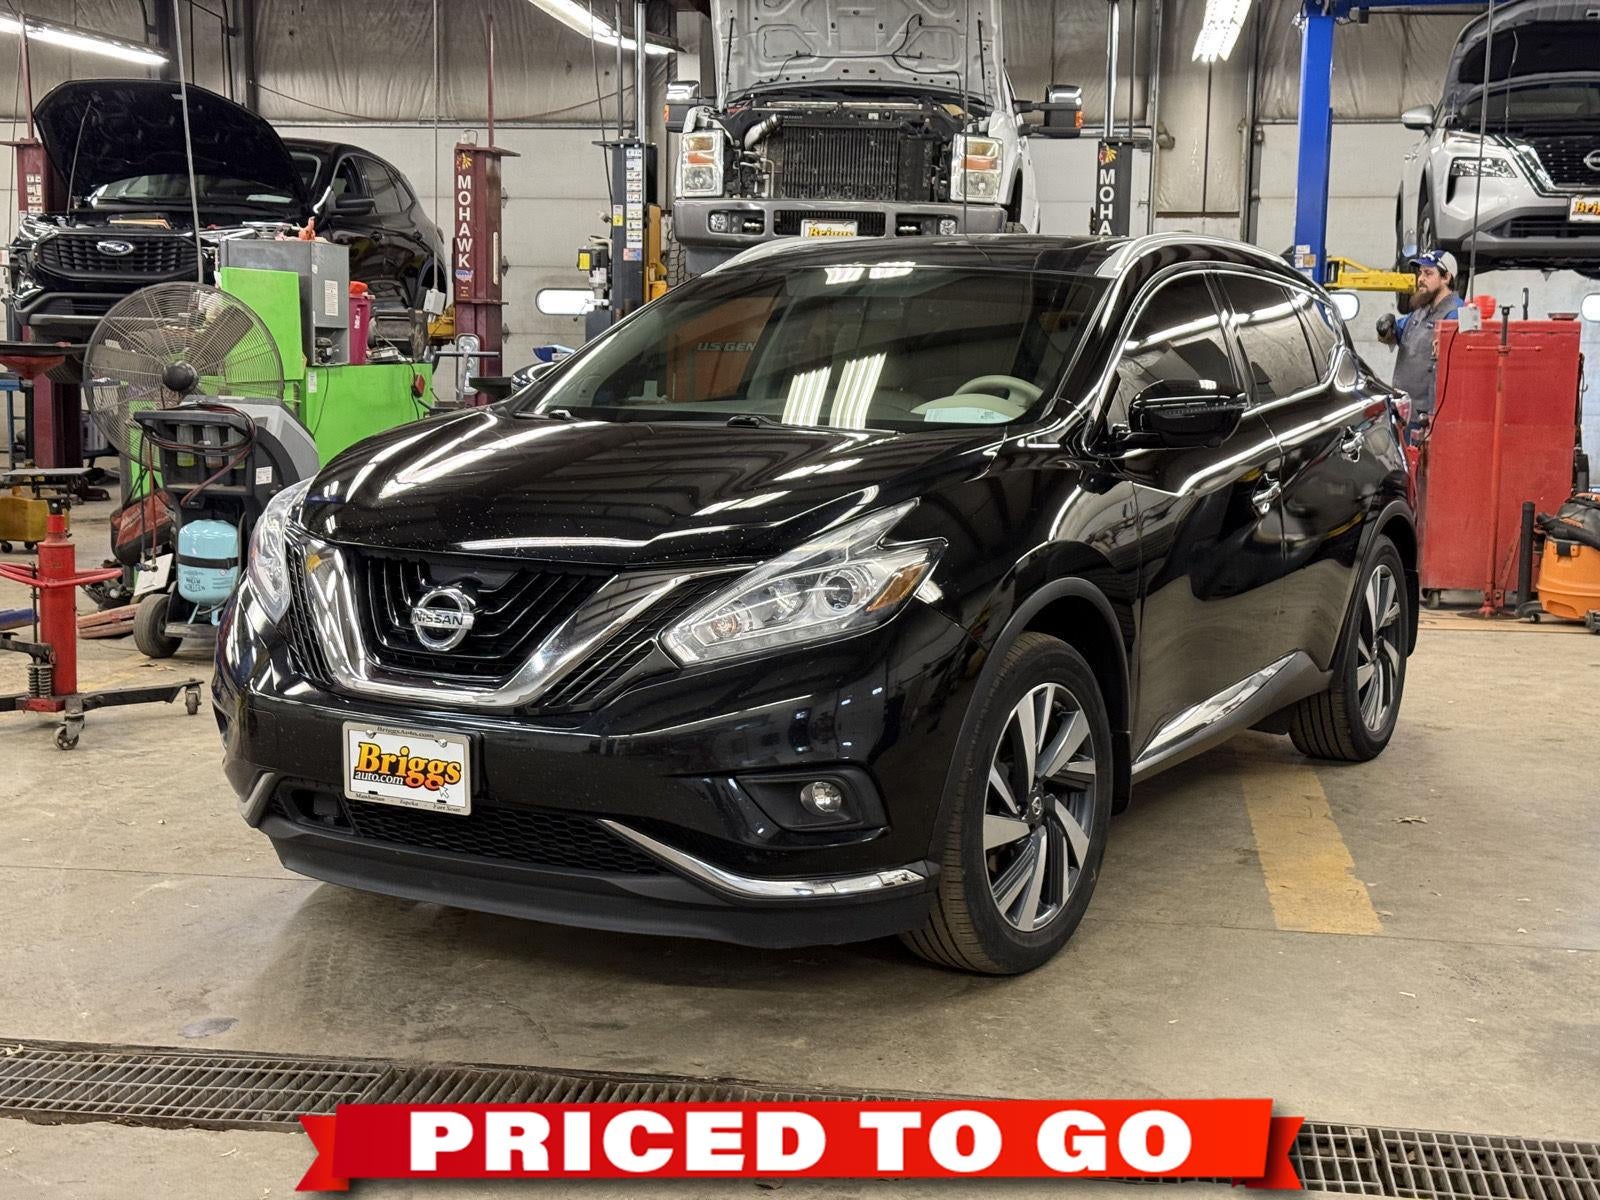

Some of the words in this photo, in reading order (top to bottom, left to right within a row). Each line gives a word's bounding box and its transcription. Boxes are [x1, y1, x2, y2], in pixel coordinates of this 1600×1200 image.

[457, 175, 473, 268] MOHAWK
[415, 612, 464, 626] NISSAN
[354, 741, 462, 791] Briggs
[354, 771, 404, 786] auto.com
